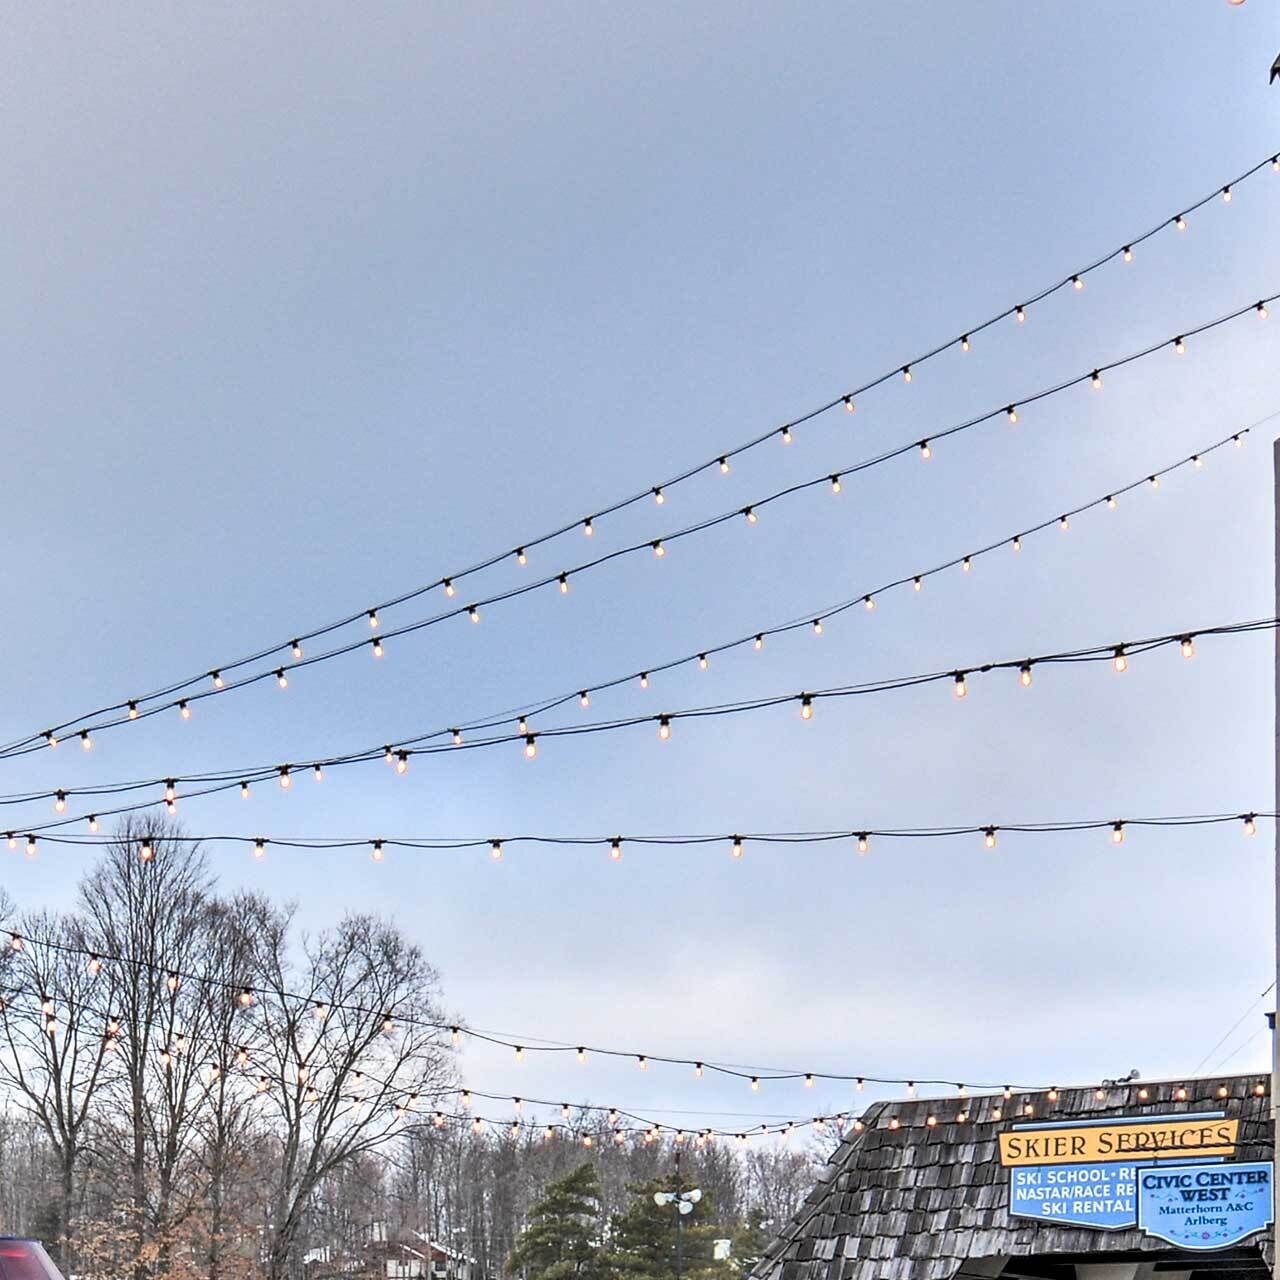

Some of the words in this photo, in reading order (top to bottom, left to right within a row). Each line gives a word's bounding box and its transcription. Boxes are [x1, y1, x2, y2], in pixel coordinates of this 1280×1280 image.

[1007, 1136, 1086, 1158] SKIER
[1098, 1127, 1231, 1153] SERVICES
[1017, 1172, 1041, 1185] SKI
[1047, 1170, 1109, 1183] SCHOOL
[1143, 1175, 1192, 1189] CIVIC
[1195, 1170, 1268, 1186] CENTER
[1016, 1185, 1110, 1201] NASTAR/RACE
[1179, 1188, 1231, 1202] WEST
[1042, 1202, 1066, 1215] SKI
[1159, 1204, 1223, 1215] Matterhorn
[1226, 1202, 1254, 1212] A&C
[1185, 1216, 1227, 1226] Arlberg
